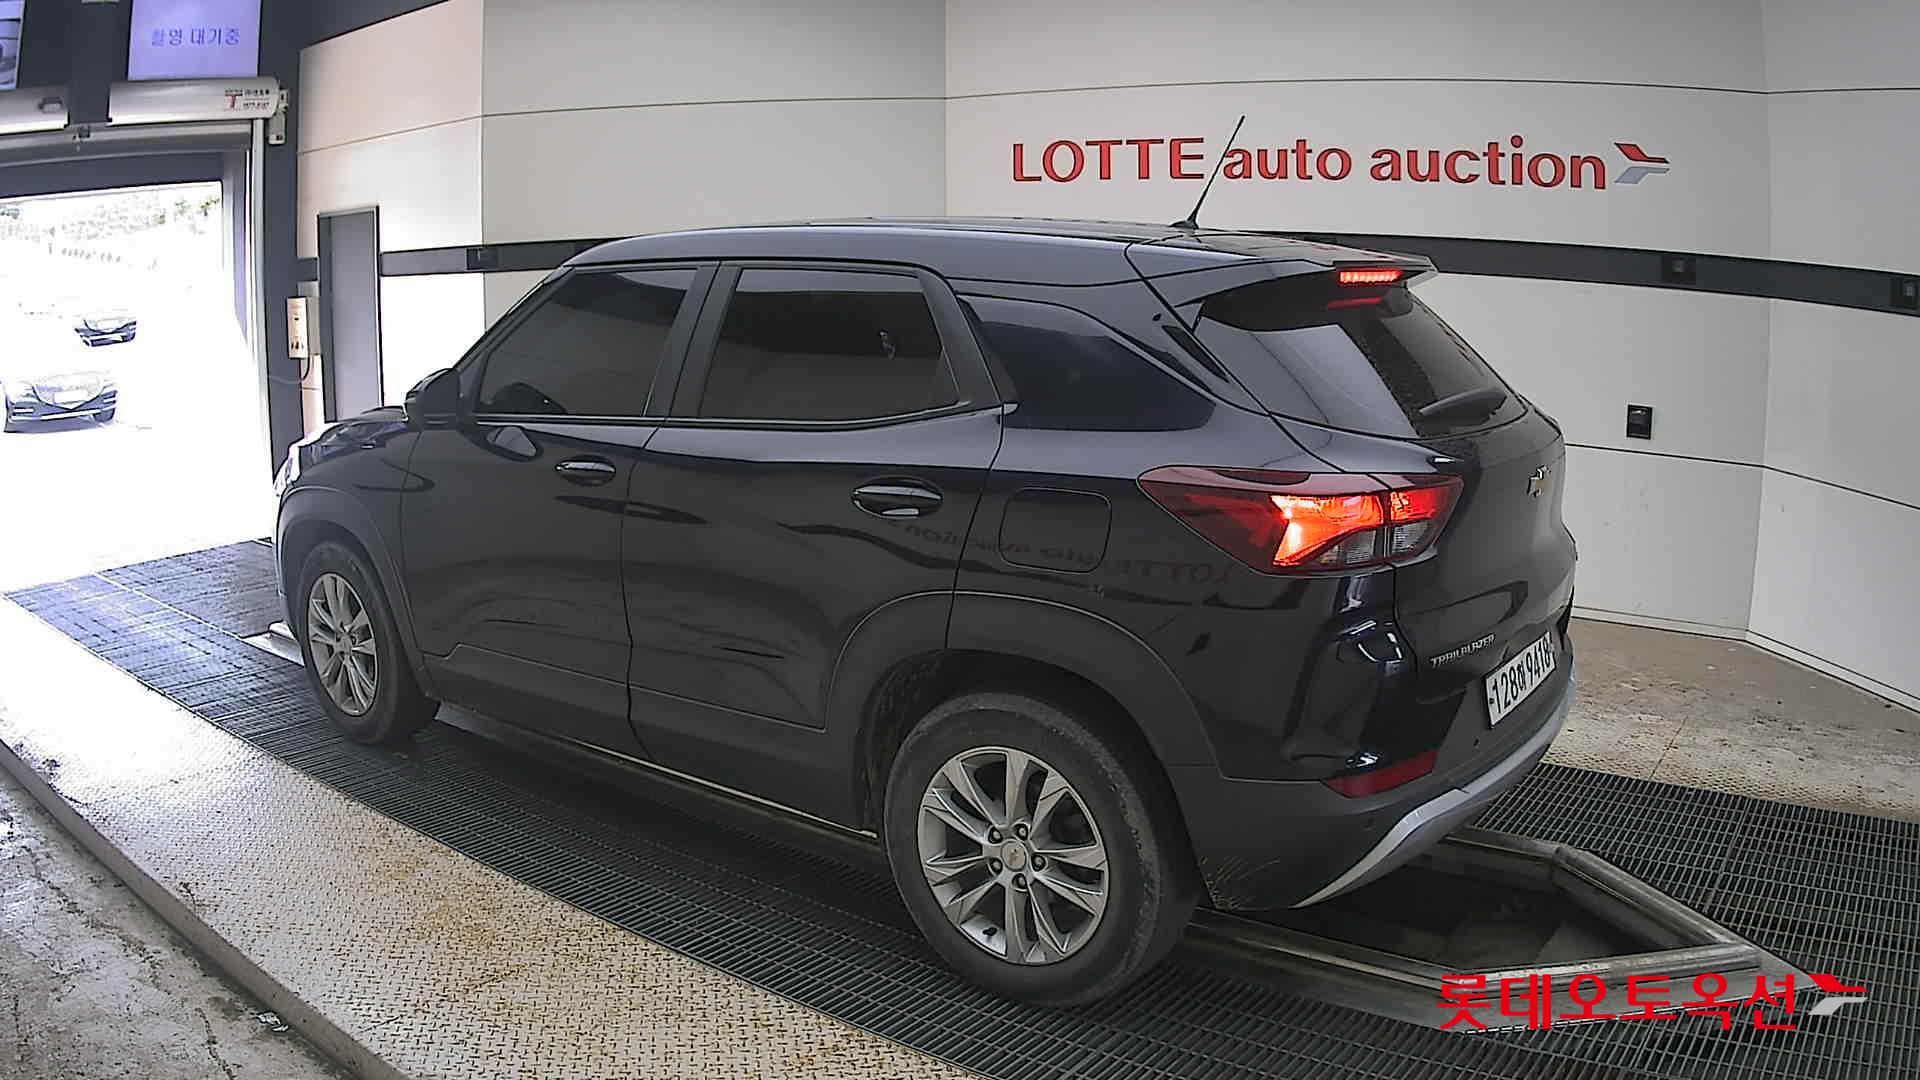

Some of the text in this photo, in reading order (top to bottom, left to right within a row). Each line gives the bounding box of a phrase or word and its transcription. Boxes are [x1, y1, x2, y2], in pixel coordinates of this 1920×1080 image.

[191, 27, 240, 46] 대기중
[1012, 135, 1606, 189] LOTTE auto auction
